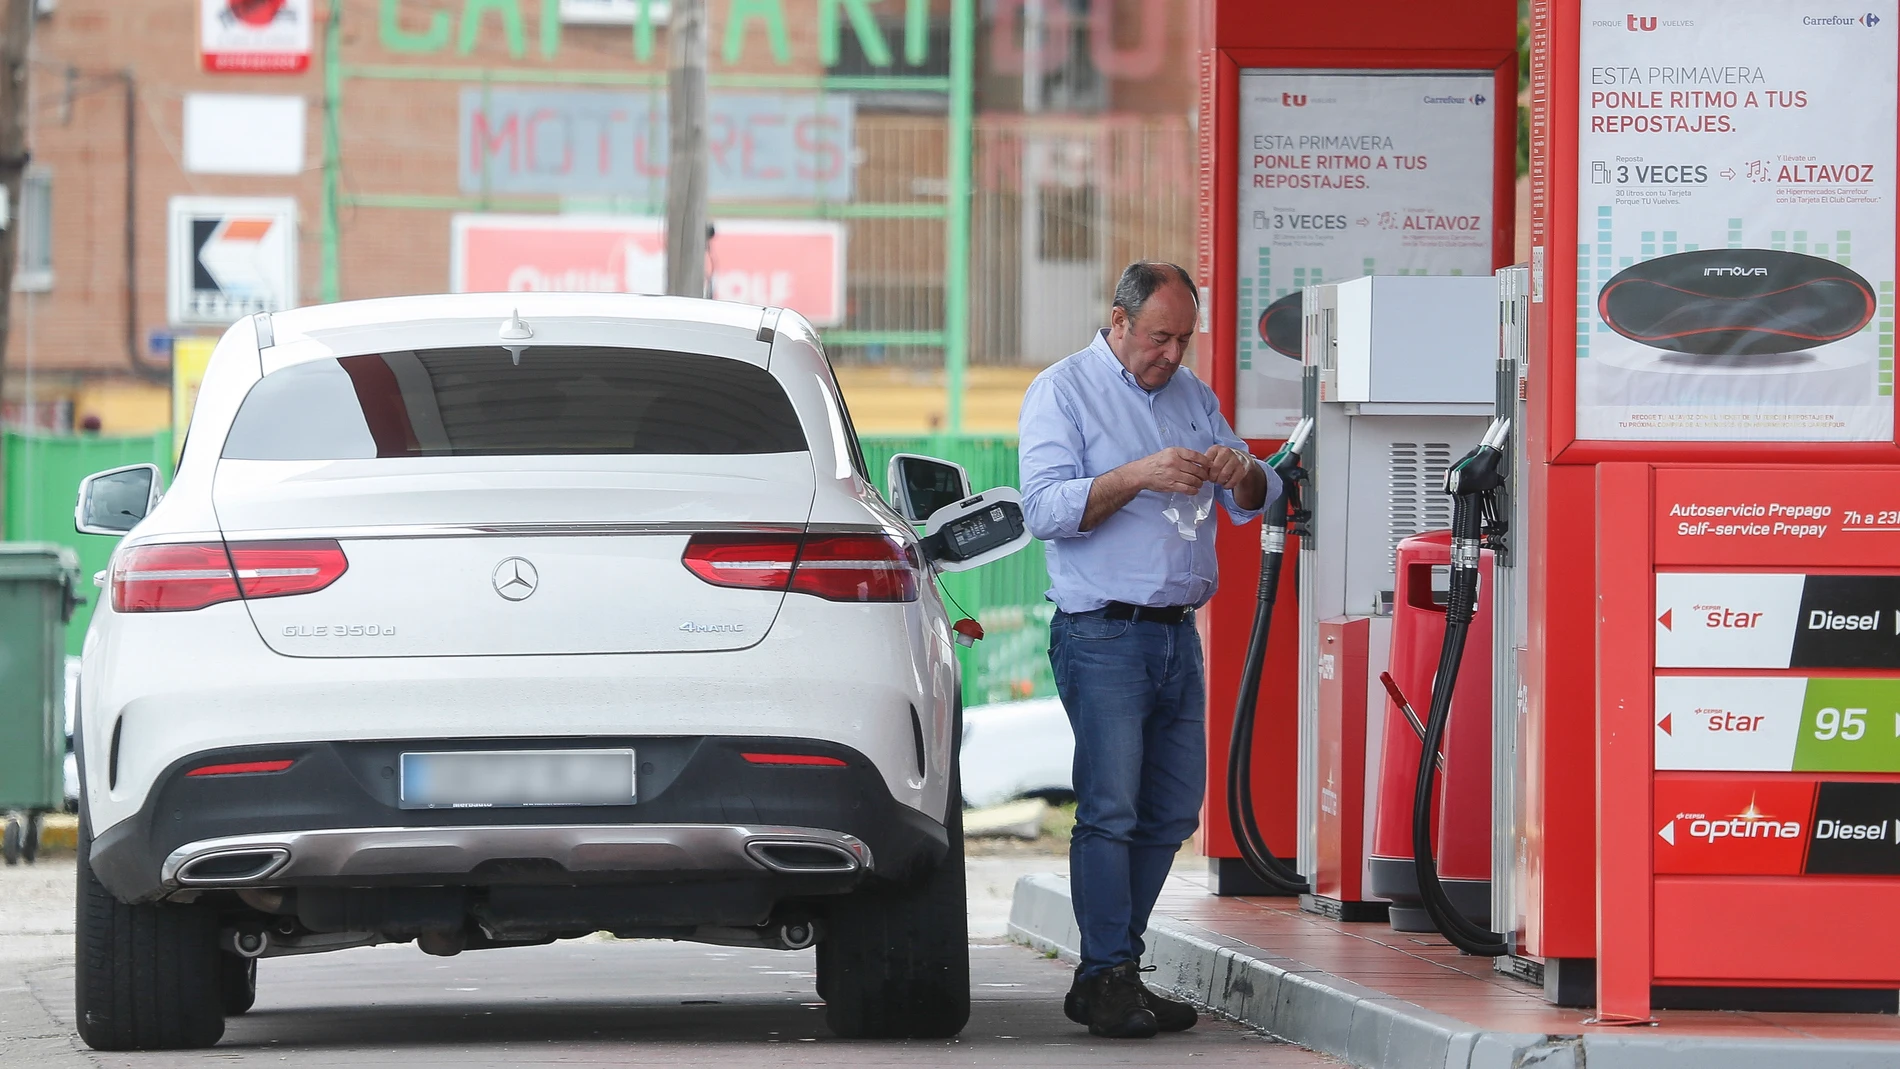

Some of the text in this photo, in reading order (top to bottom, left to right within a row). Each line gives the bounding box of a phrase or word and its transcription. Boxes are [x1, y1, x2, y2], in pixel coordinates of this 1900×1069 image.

[1626, 13, 1658, 32] tu
[1802, 15, 1855, 27] Carrefour
[1591, 66, 1766, 85] ESTA PRIMAVERA
[1591, 91, 1808, 109] PONLE RITMO A TUS
[1591, 115, 1737, 133] REPOSTAJES.
[469, 107, 846, 182] MOTORES
[1253, 135, 1395, 151] ESTA PRIMAVERA
[1253, 155, 1428, 170] PONLE RITMO A TUS
[1615, 155, 1644, 163] Reposta
[1253, 174, 1370, 189] REPOSTAJES.
[1616, 165, 1708, 184] 3 VECES
[1776, 164, 1874, 183] ALTAVOZ
[1615, 189, 1625, 197] 30
[1625, 189, 1645, 197] litros
[1668, 189, 1692, 198] Tarjeta
[1786, 188, 1836, 196] Hipermercados
[1615, 198, 1640, 206] Porque
[1798, 197, 1820, 205] Tarjeta
[1273, 214, 1347, 230] 3 VECES
[1402, 215, 1481, 231] ALTAVOZ
[1669, 503, 1832, 520] Autoservicio Prepago
[1843, 511, 1862, 525] 7h
[1864, 514, 1875, 525] a
[1677, 522, 1828, 538] Self-service Prepay
[1706, 608, 1763, 628] star
[1808, 610, 1881, 631] Diesel
[282, 624, 329, 637] GLE
[679, 621, 744, 633] 4MATIC
[1707, 711, 1765, 732] star
[1814, 707, 1868, 741] 95
[1689, 818, 1801, 844] optima
[1815, 819, 1888, 840] Diesel
